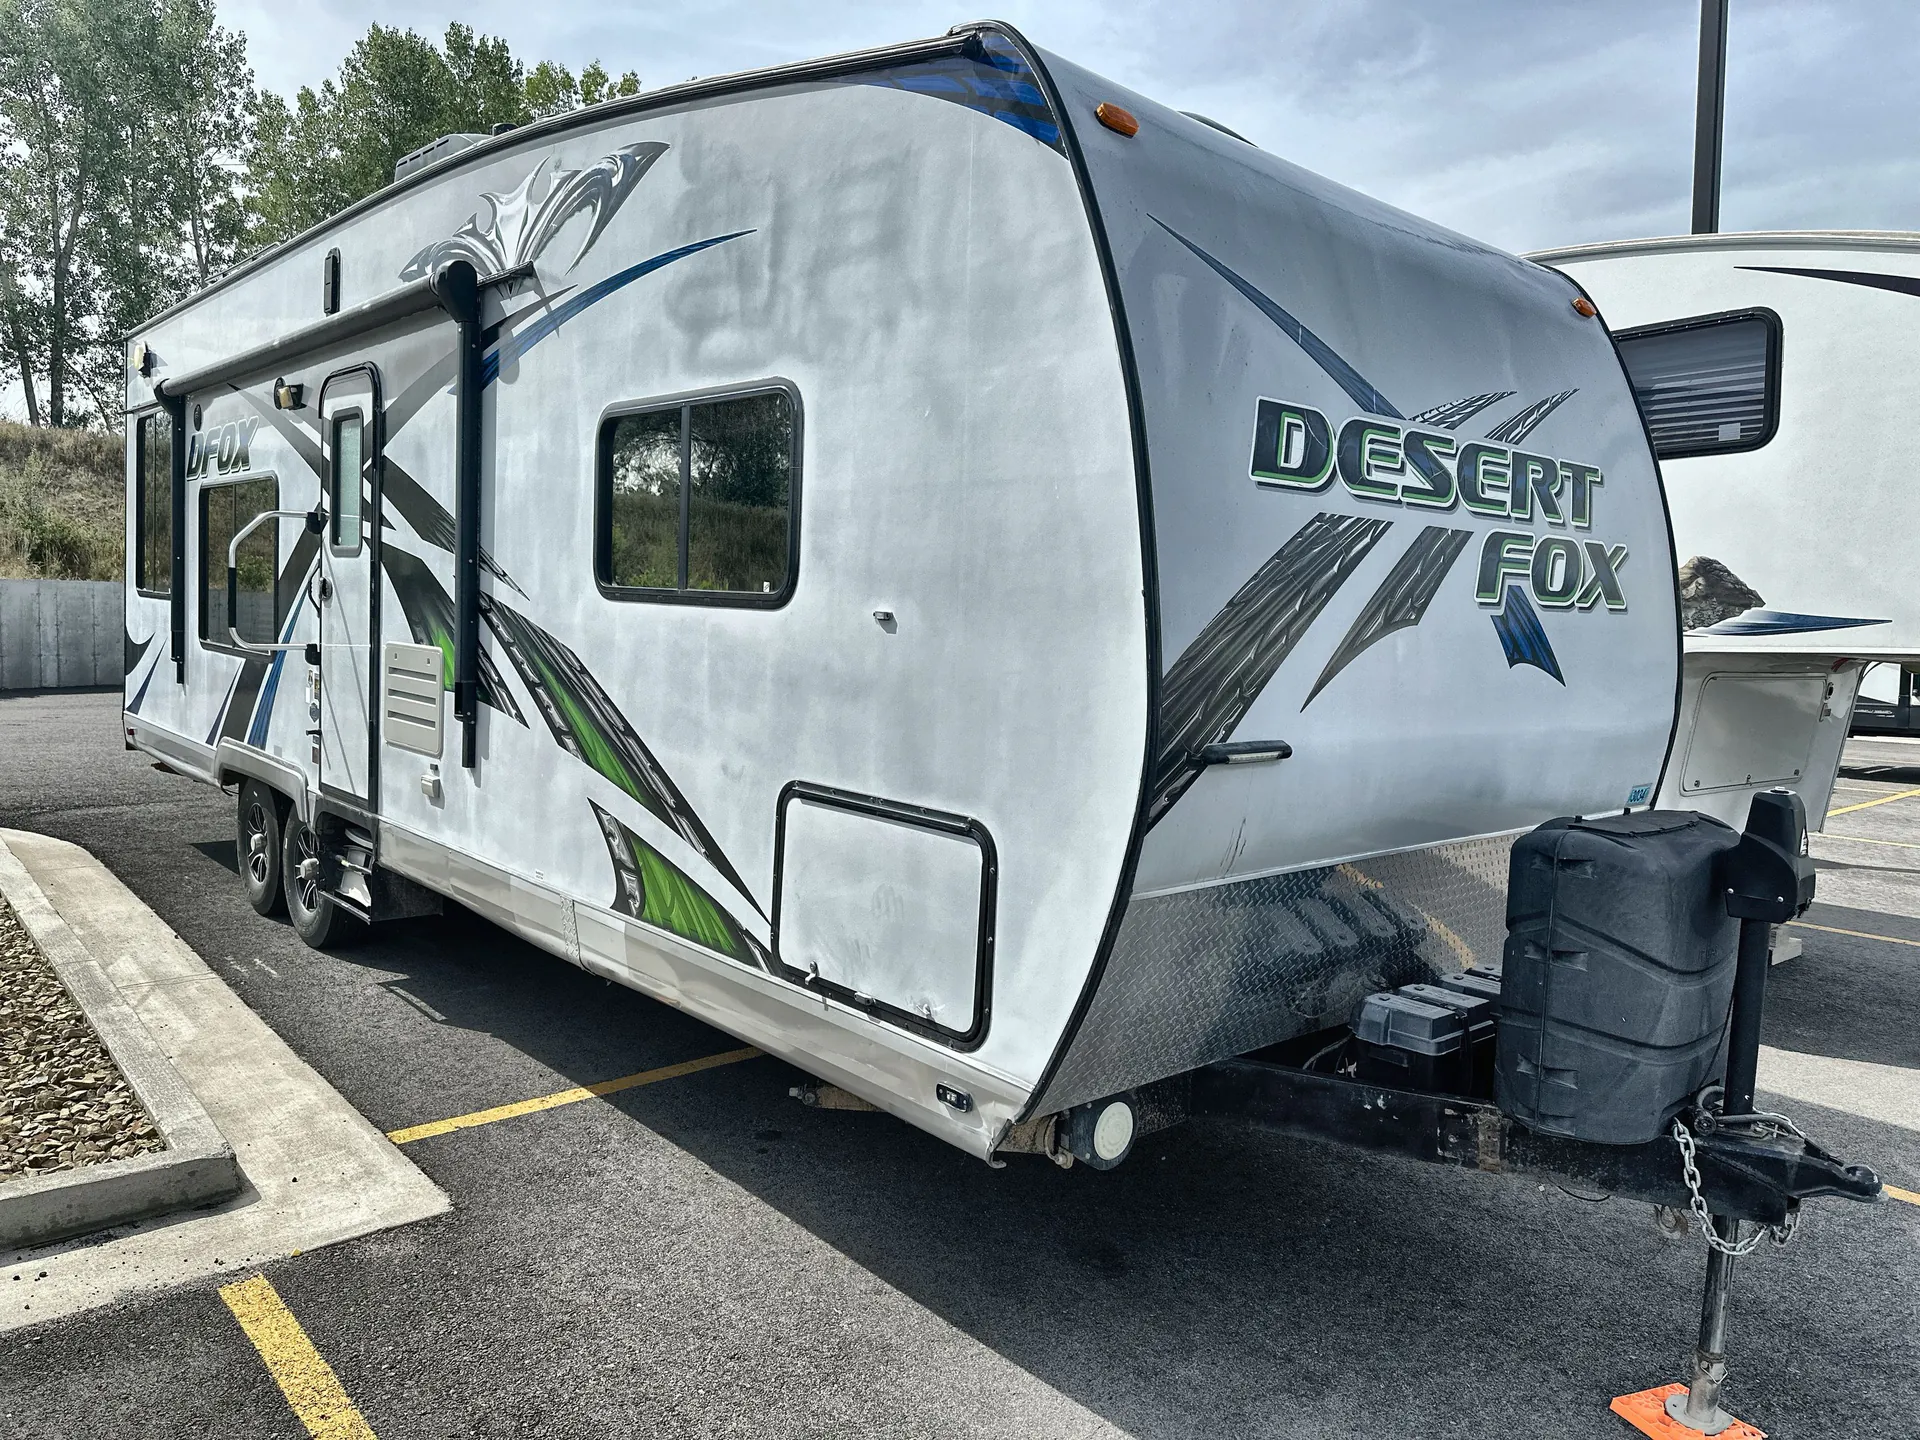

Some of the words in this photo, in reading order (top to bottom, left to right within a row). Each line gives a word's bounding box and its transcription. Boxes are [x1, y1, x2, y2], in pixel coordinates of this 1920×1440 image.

[186, 416, 260, 481] DFOX
[1248, 395, 1604, 528] DESERT
[1474, 528, 1628, 611] FOX
